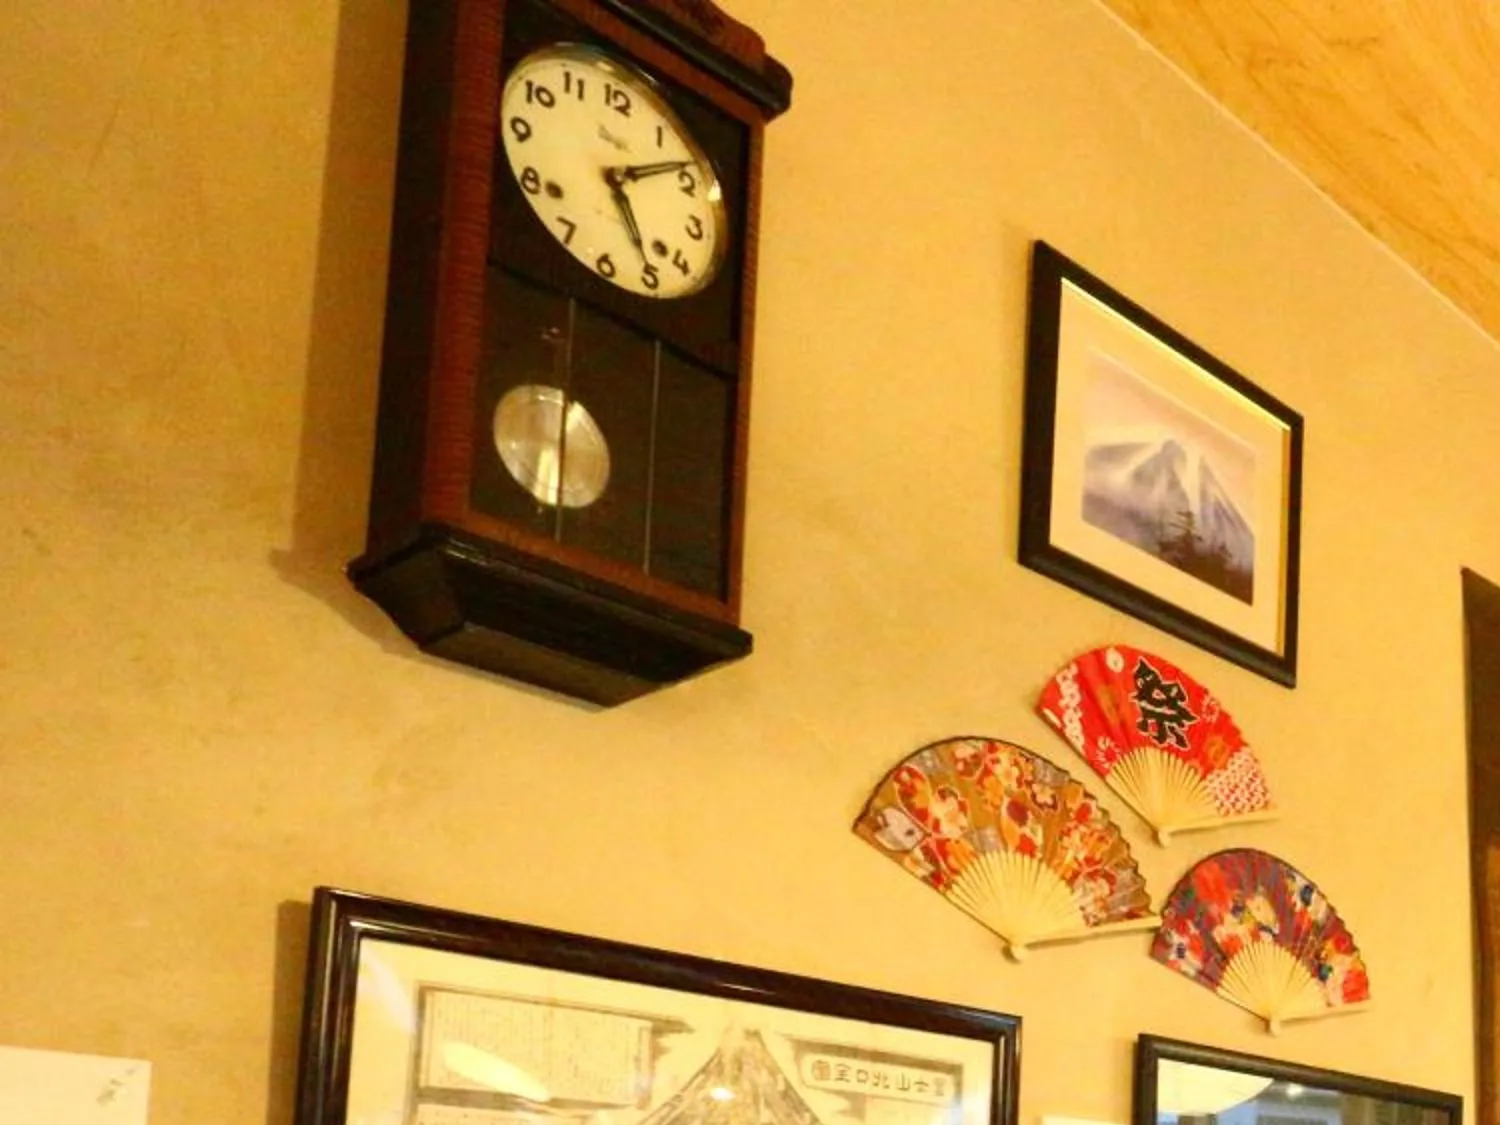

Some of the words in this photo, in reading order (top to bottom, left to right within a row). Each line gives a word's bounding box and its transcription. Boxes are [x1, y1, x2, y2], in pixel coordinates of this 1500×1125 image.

[525, 80, 555, 108] 10
[563, 71, 584, 101] 11
[604, 83, 631, 118] 12
[510, 117, 532, 142] 9
[655, 125, 663, 148] 1
[521, 167, 541, 195] 8
[677, 169, 696, 198] 2
[556, 216, 577, 245] 7
[685, 214, 703, 241] 3
[596, 253, 616, 278] 6
[641, 263, 660, 290] 5
[672, 249, 691, 277] 4
